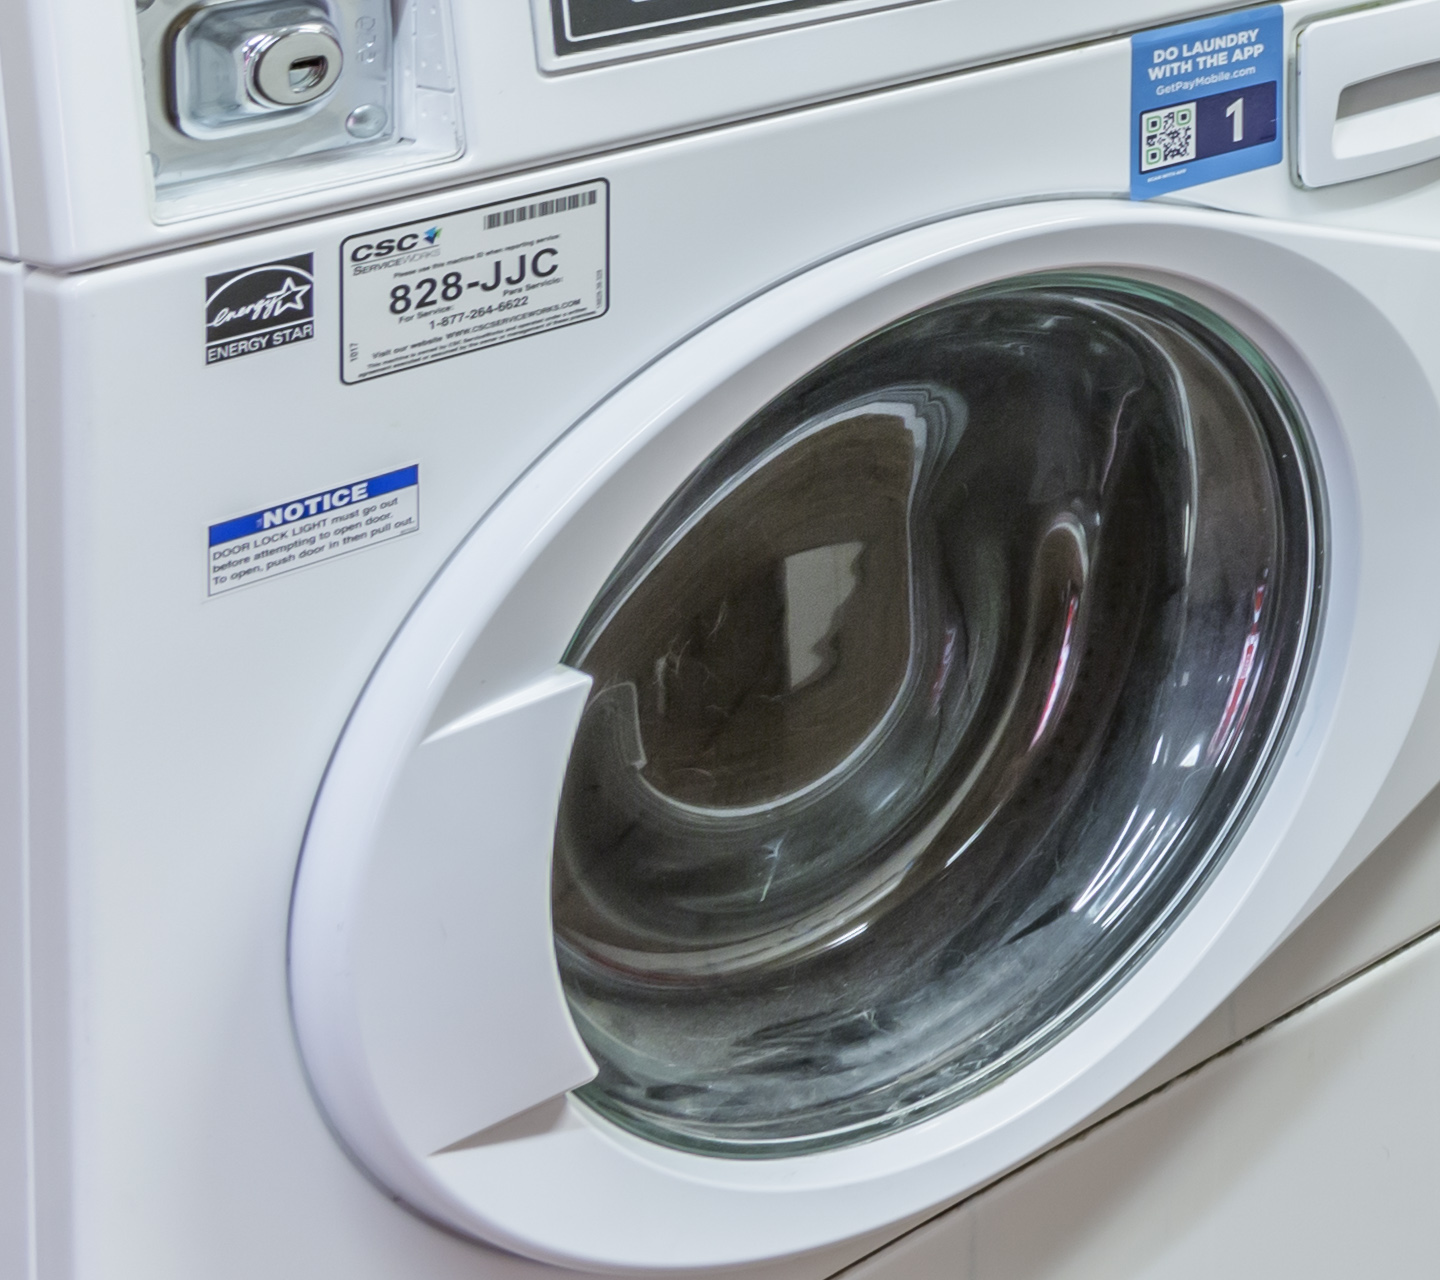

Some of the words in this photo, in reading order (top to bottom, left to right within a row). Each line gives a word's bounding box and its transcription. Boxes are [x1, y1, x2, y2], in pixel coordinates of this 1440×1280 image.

[1148, 60, 1193, 81] WITH
[1196, 52, 1228, 71] THE
[1231, 44, 1264, 62] APP
[1153, 46, 1179, 63] DO
[1182, 28, 1259, 58] LAUNDRY
[1156, 66, 1256, 96] GetPayMobile.com
[1225, 97, 1244, 143] 1
[351, 233, 419, 262] CSC
[389, 248, 559, 315] 828-JJC
[503, 287, 523, 297] Para
[399, 315, 414, 324] For
[416, 305, 454, 319] Service:
[429, 296, 529, 330] 1-877-264-6622
[208, 334, 270, 362] ENERGY
[272, 324, 313, 345] STAR
[372, 348, 391, 359] Visit
[393, 345, 409, 354] our
[410, 336, 443, 349] website
[262, 482, 369, 529] NOTICE
[213, 543, 250, 561] DOOR
[253, 530, 288, 549] LOCK
[292, 518, 328, 537] LIGHT
[331, 509, 360, 524] must
[363, 504, 377, 516] go
[379, 497, 398, 509] out
[213, 556, 250, 573] before
[253, 537, 316, 561] attempting
[319, 530, 331, 540] to
[333, 520, 362, 537] open
[365, 512, 394, 526] door.
[213, 574, 227, 586] To
[230, 564, 263, 581] open,
[266, 554, 295, 571] push
[299, 543, 325, 559] door
[329, 538, 340, 549] in
[342, 531, 368, 546] then
[370, 523, 391, 539] pull
[394, 516, 416, 529] out.
